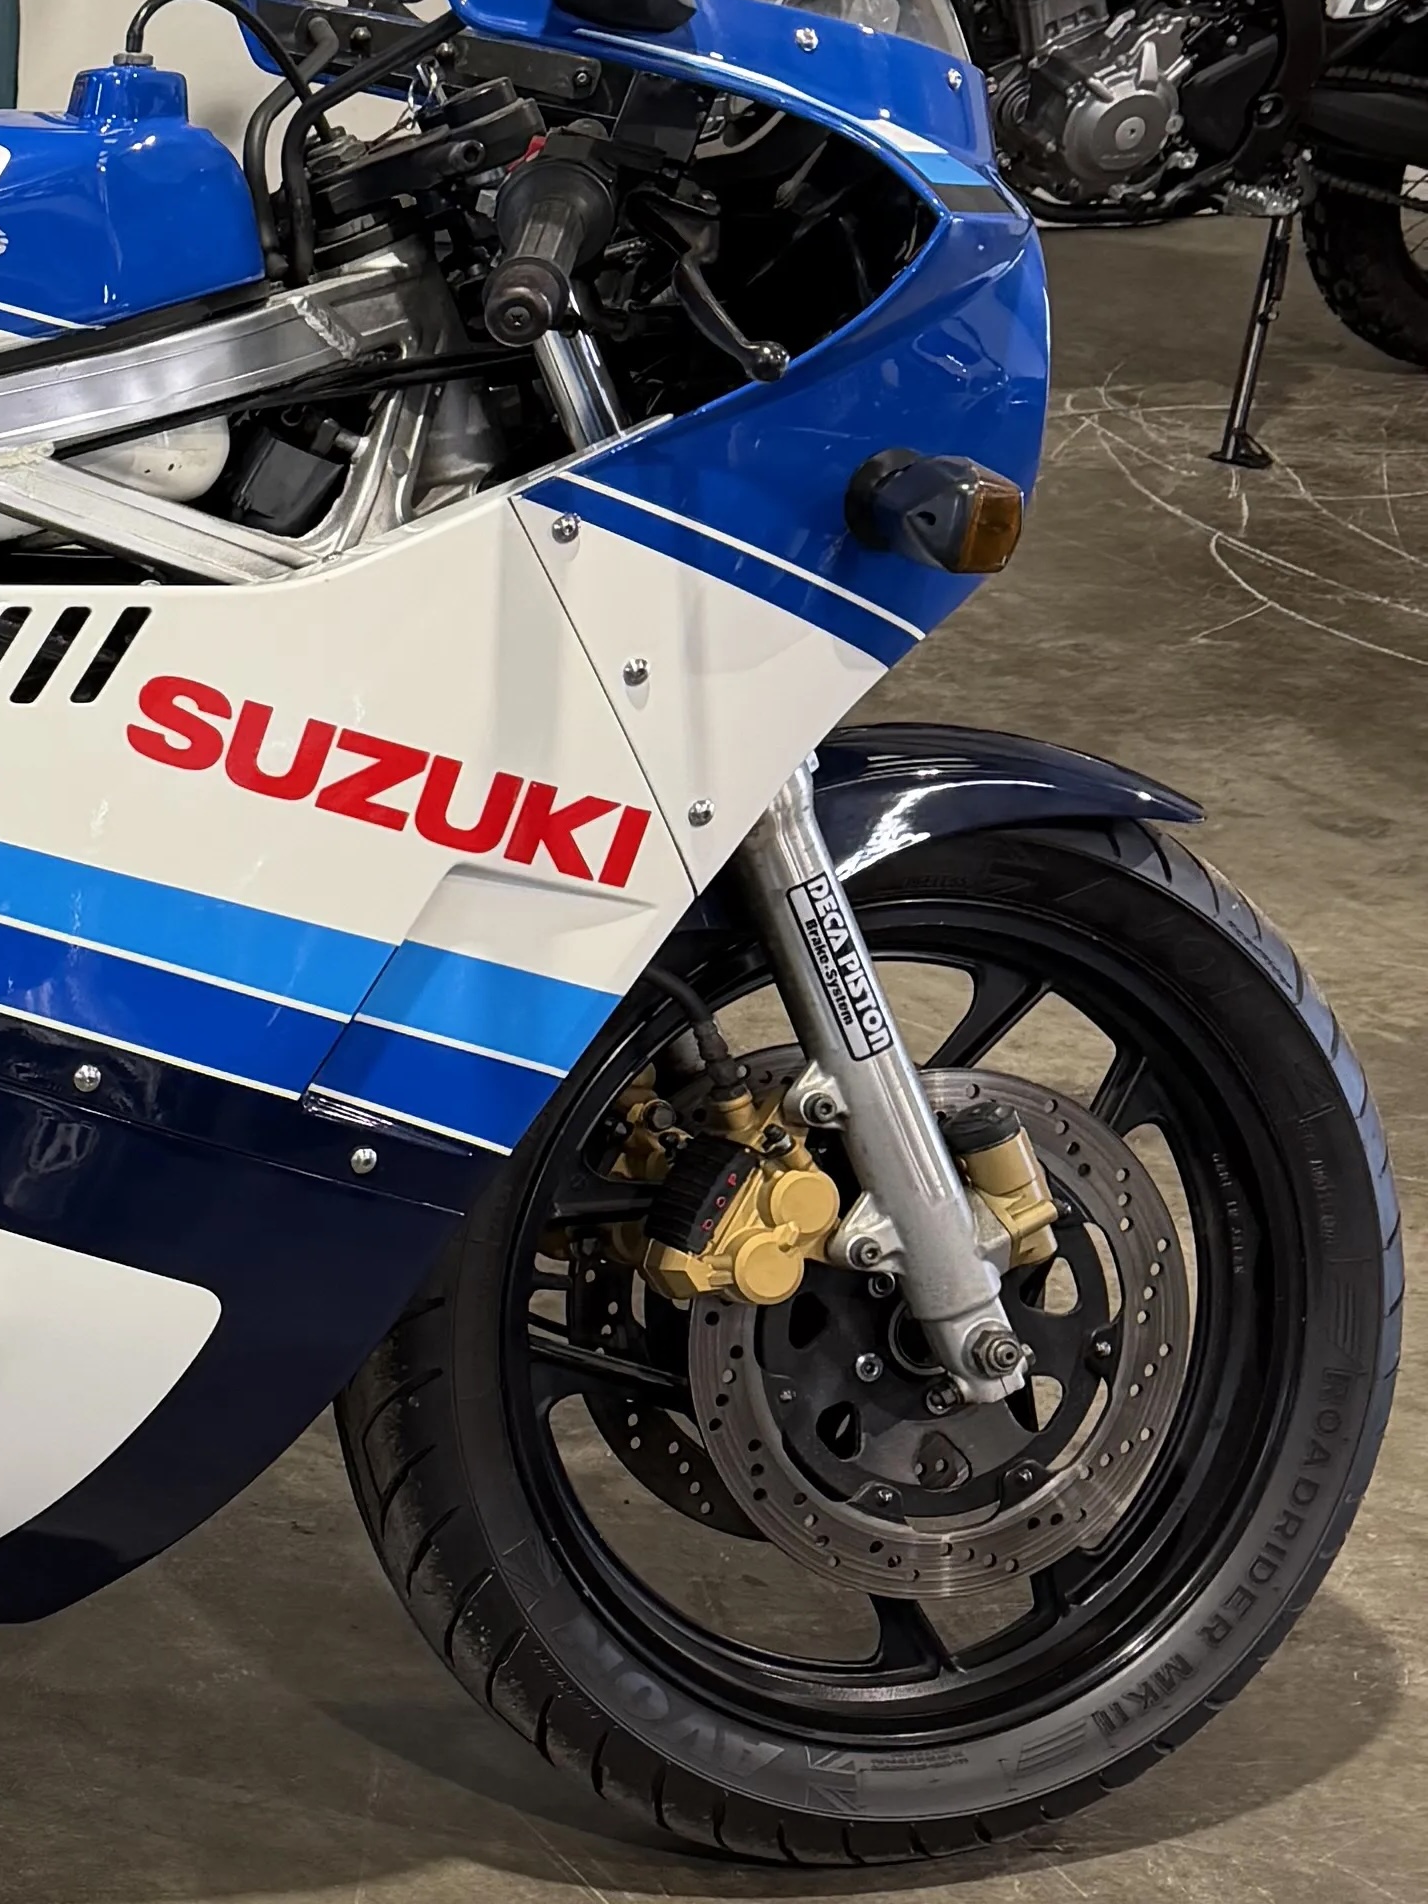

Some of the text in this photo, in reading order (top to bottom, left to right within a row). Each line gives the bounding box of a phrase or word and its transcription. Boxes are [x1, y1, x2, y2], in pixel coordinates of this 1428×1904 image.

[127, 675, 652, 888] SUZUKI
[807, 875, 850, 953] DECA
[1195, 1366, 1350, 1650] ROADRIDER
[551, 1612, 785, 1779] AVON
